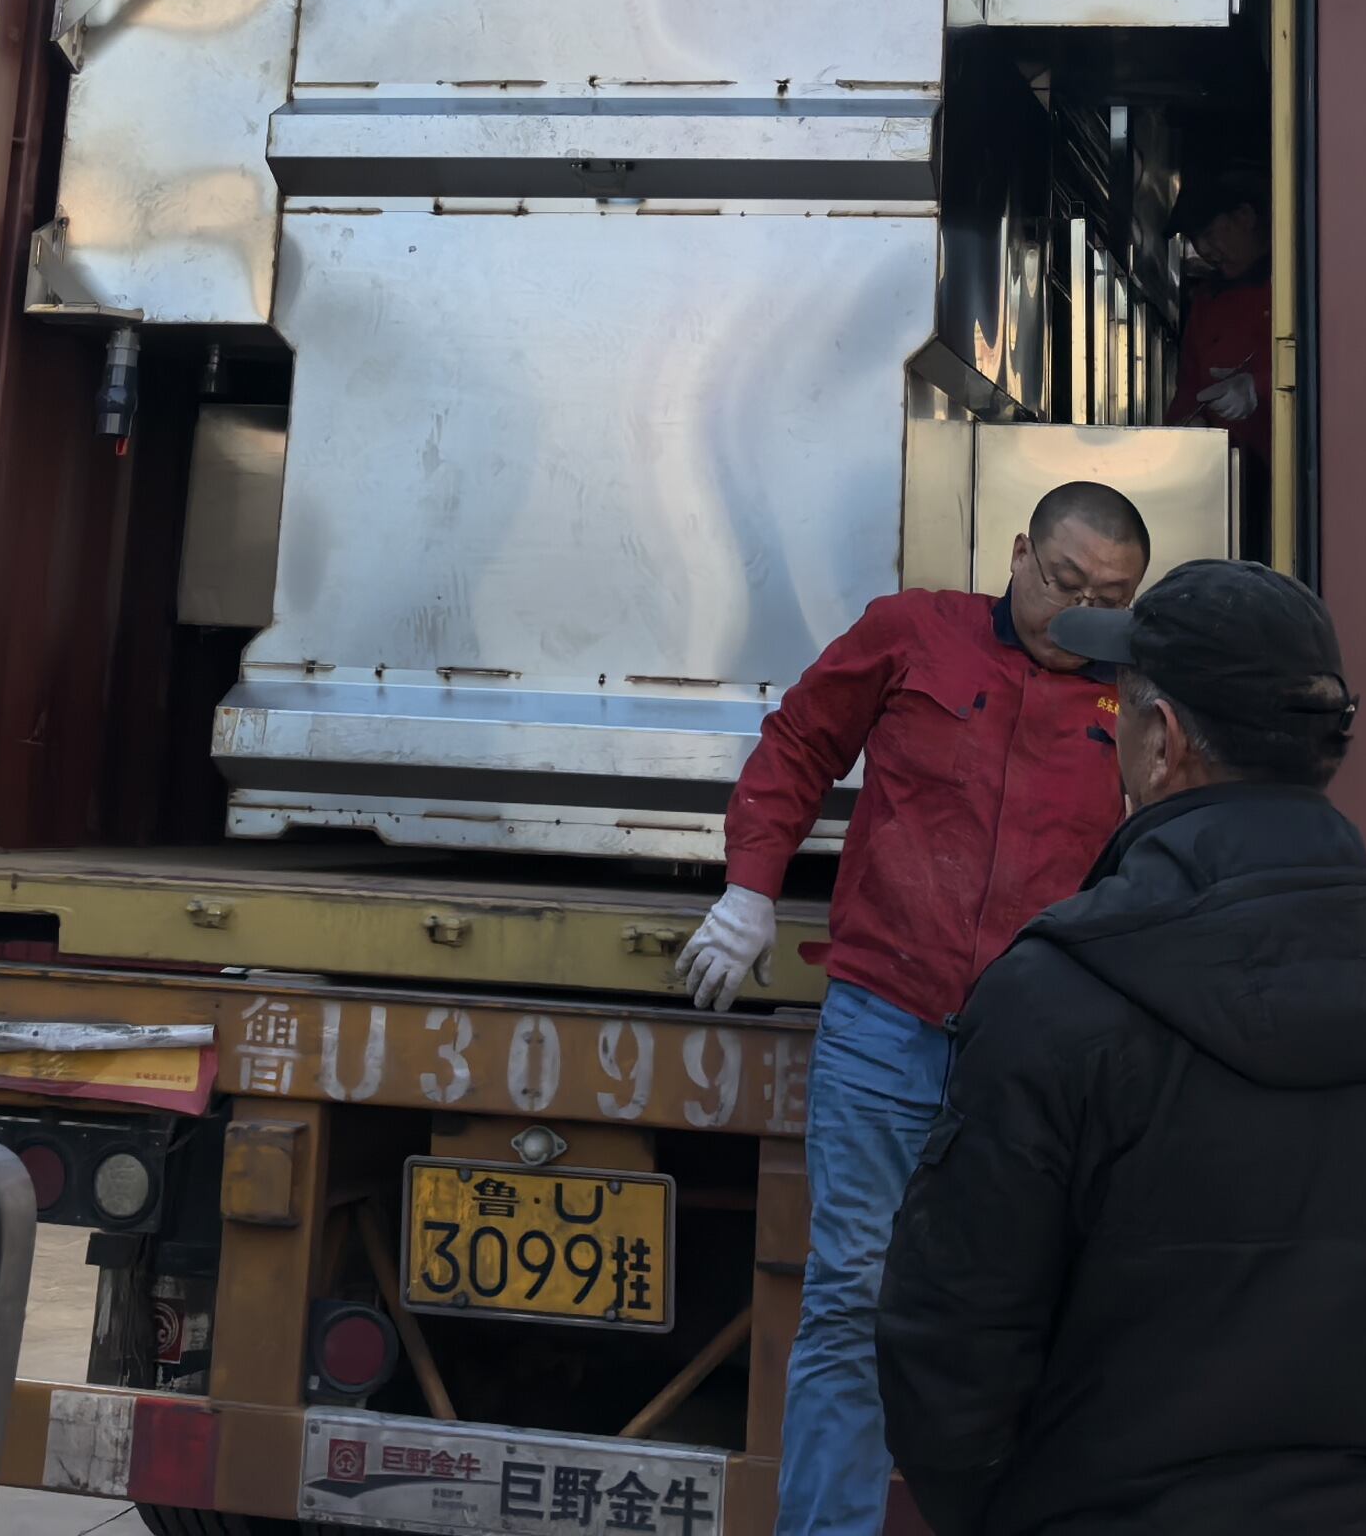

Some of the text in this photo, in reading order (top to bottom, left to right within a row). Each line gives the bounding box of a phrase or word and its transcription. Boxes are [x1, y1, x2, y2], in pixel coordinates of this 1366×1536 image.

[421, 1220, 652, 1311] 3099挂
[381, 1445, 482, 1481] 巨野金牛
[500, 1460, 714, 1536] 巨野金牛
